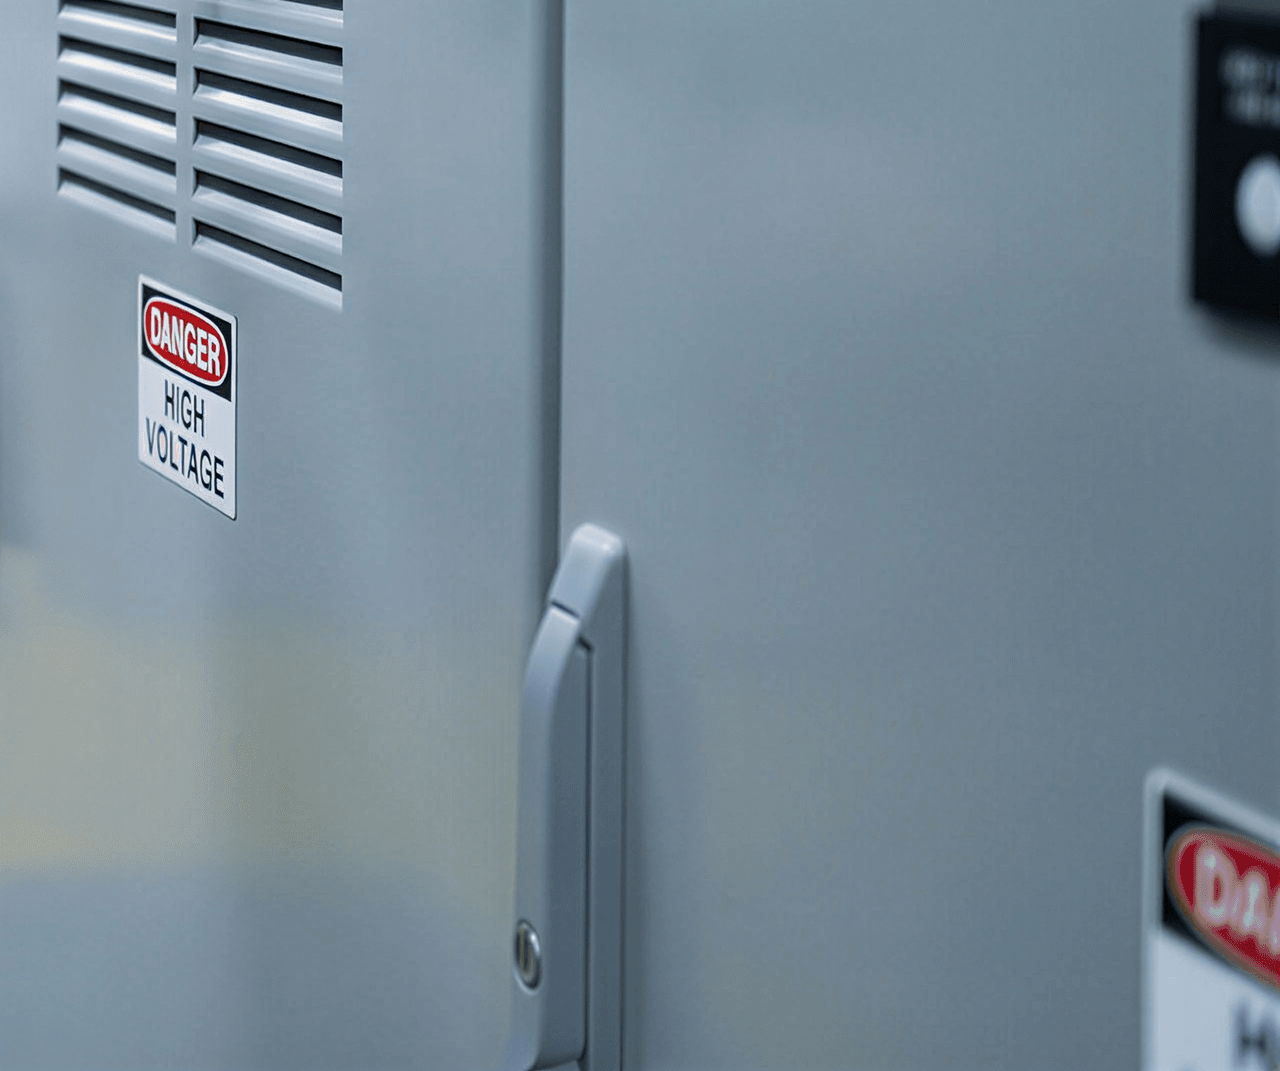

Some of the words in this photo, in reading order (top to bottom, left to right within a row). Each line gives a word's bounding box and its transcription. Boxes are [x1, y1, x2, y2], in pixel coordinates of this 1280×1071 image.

[149, 305, 221, 378] DANGER
[163, 378, 206, 439] HIGH
[145, 416, 225, 500] VOLTAGE
